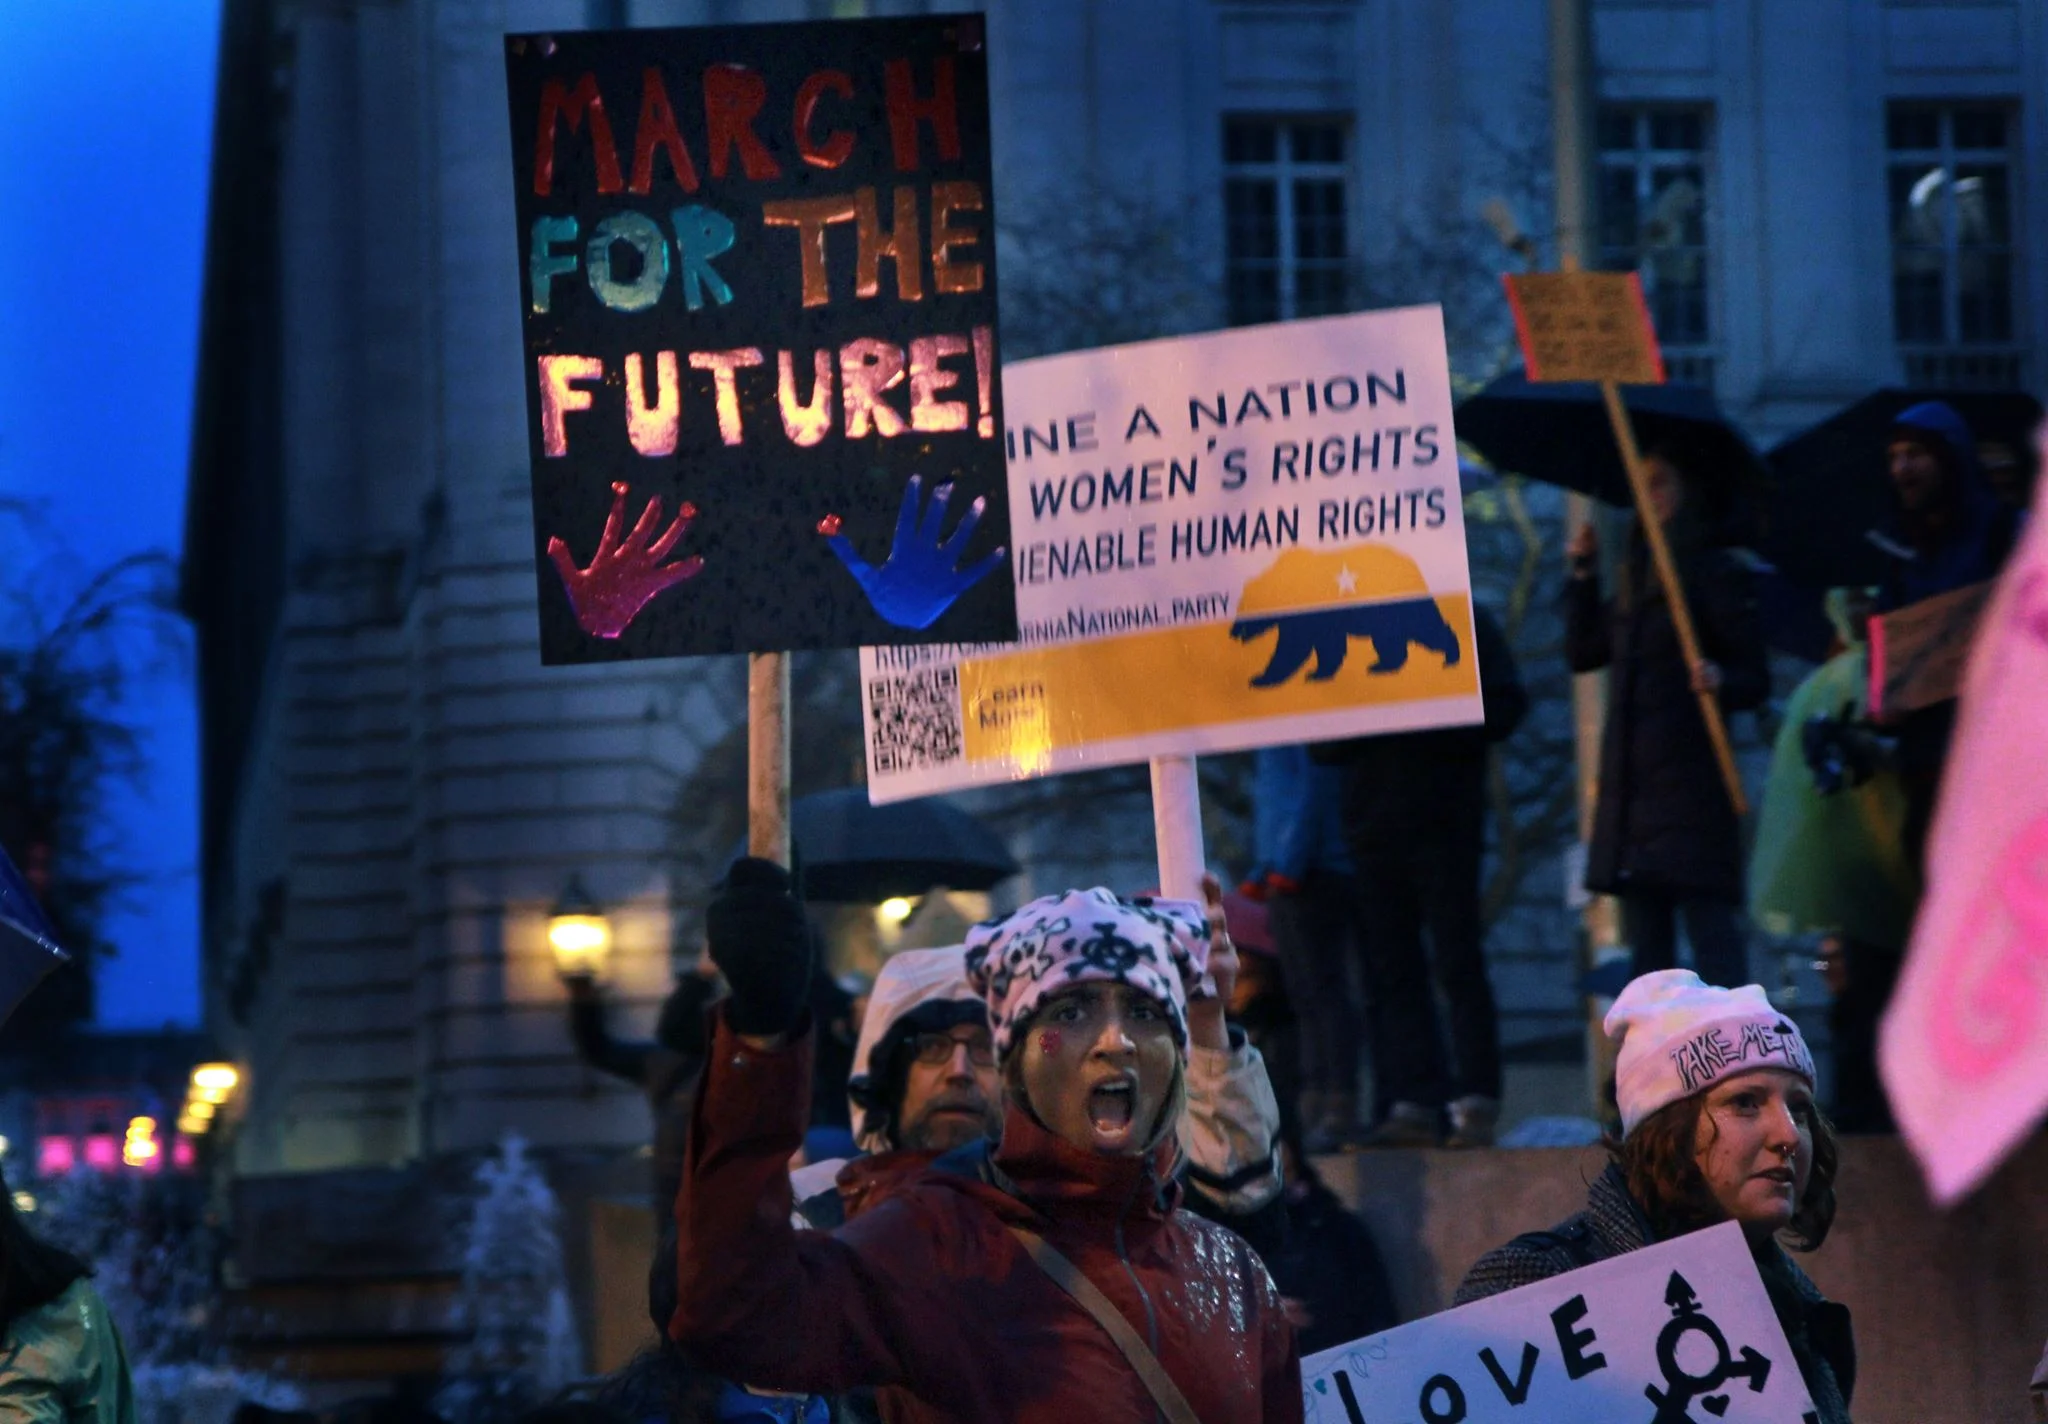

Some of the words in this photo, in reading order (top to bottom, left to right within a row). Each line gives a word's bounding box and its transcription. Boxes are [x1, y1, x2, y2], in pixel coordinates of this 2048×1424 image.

[534, 57, 961, 196] MARCH
[530, 205, 735, 314] FOR
[762, 181, 984, 308] THE
[537, 325, 994, 457] FUTURE!
[1125, 404, 1161, 441] A
[1189, 369, 1407, 431] NATION
[1030, 436, 1247, 519] WOMEN'S
[1272, 424, 1439, 484] RIGHTS
[1171, 504, 1299, 562] HUMAN
[1318, 487, 1446, 541] RIGHTS
[1670, 1029, 1740, 1092] TAKE
[1738, 1023, 1783, 1061] ME
